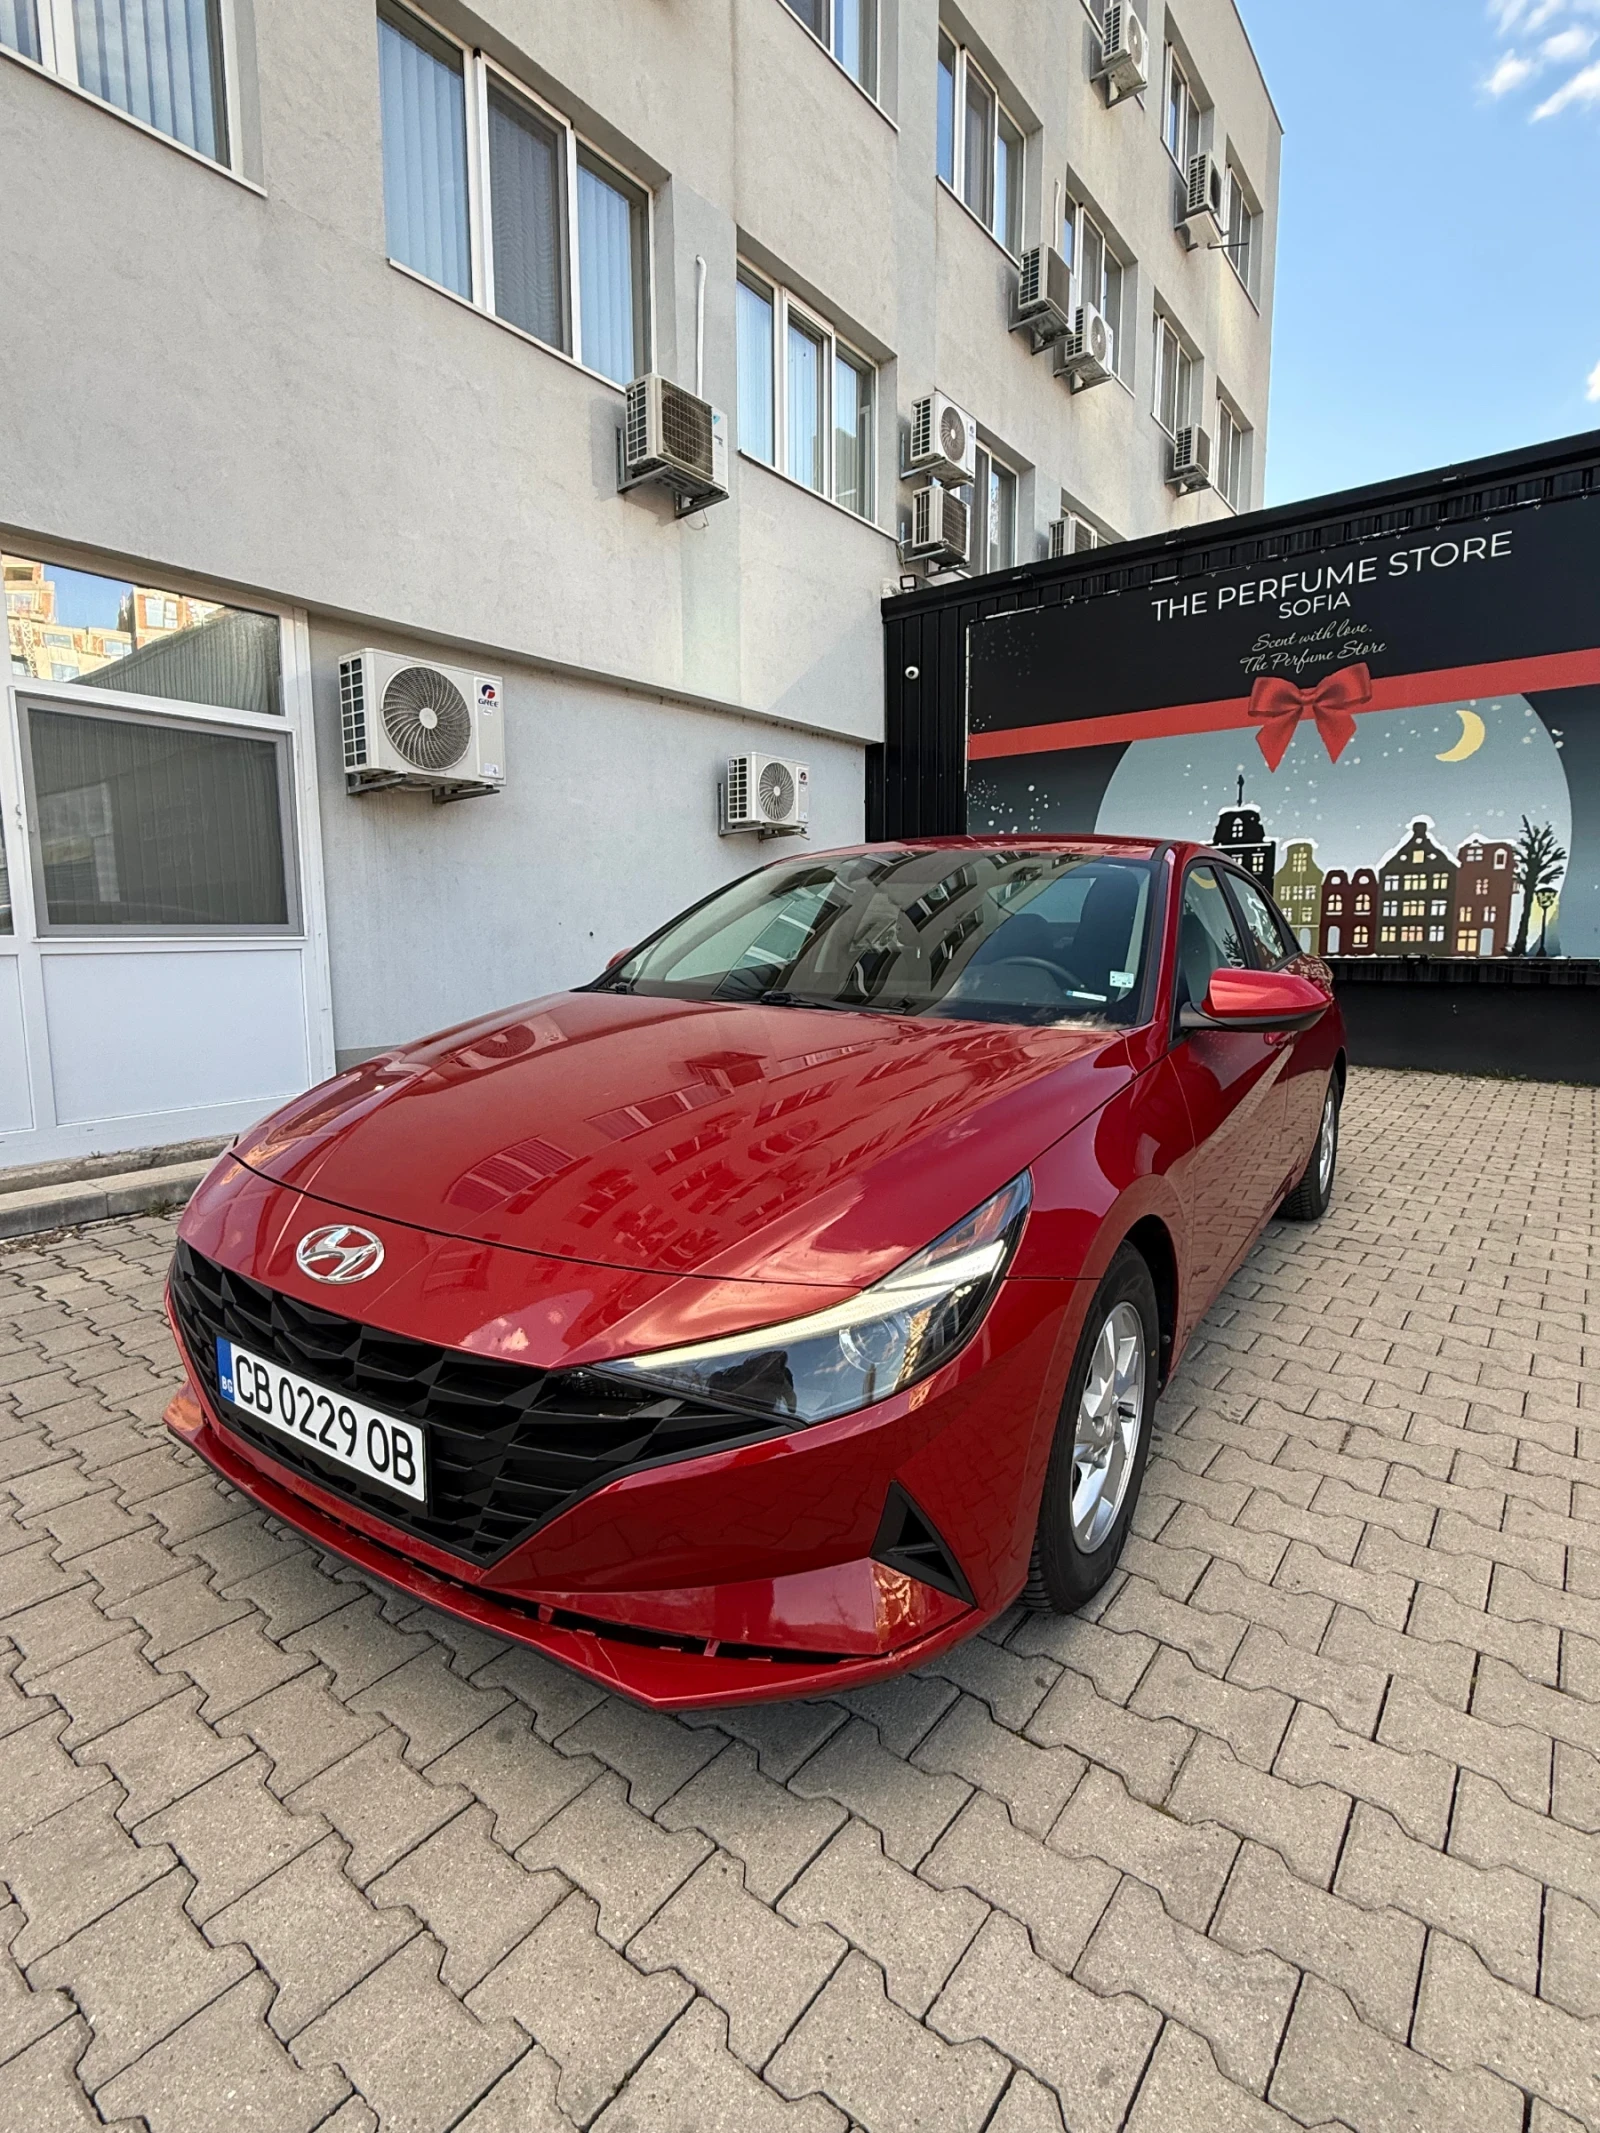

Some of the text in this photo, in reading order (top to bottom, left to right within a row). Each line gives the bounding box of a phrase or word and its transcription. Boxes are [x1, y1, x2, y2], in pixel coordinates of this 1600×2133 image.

[1151, 530, 1513, 621] THE PERFUME STORE
[1278, 591, 1351, 619] SOFIA
[1251, 618, 1373, 652] Scent with love.
[1239, 640, 1387, 674] The Perfume Store
[221, 1375, 233, 1393] BG
[236, 1355, 416, 1486] CB 0229 OB
